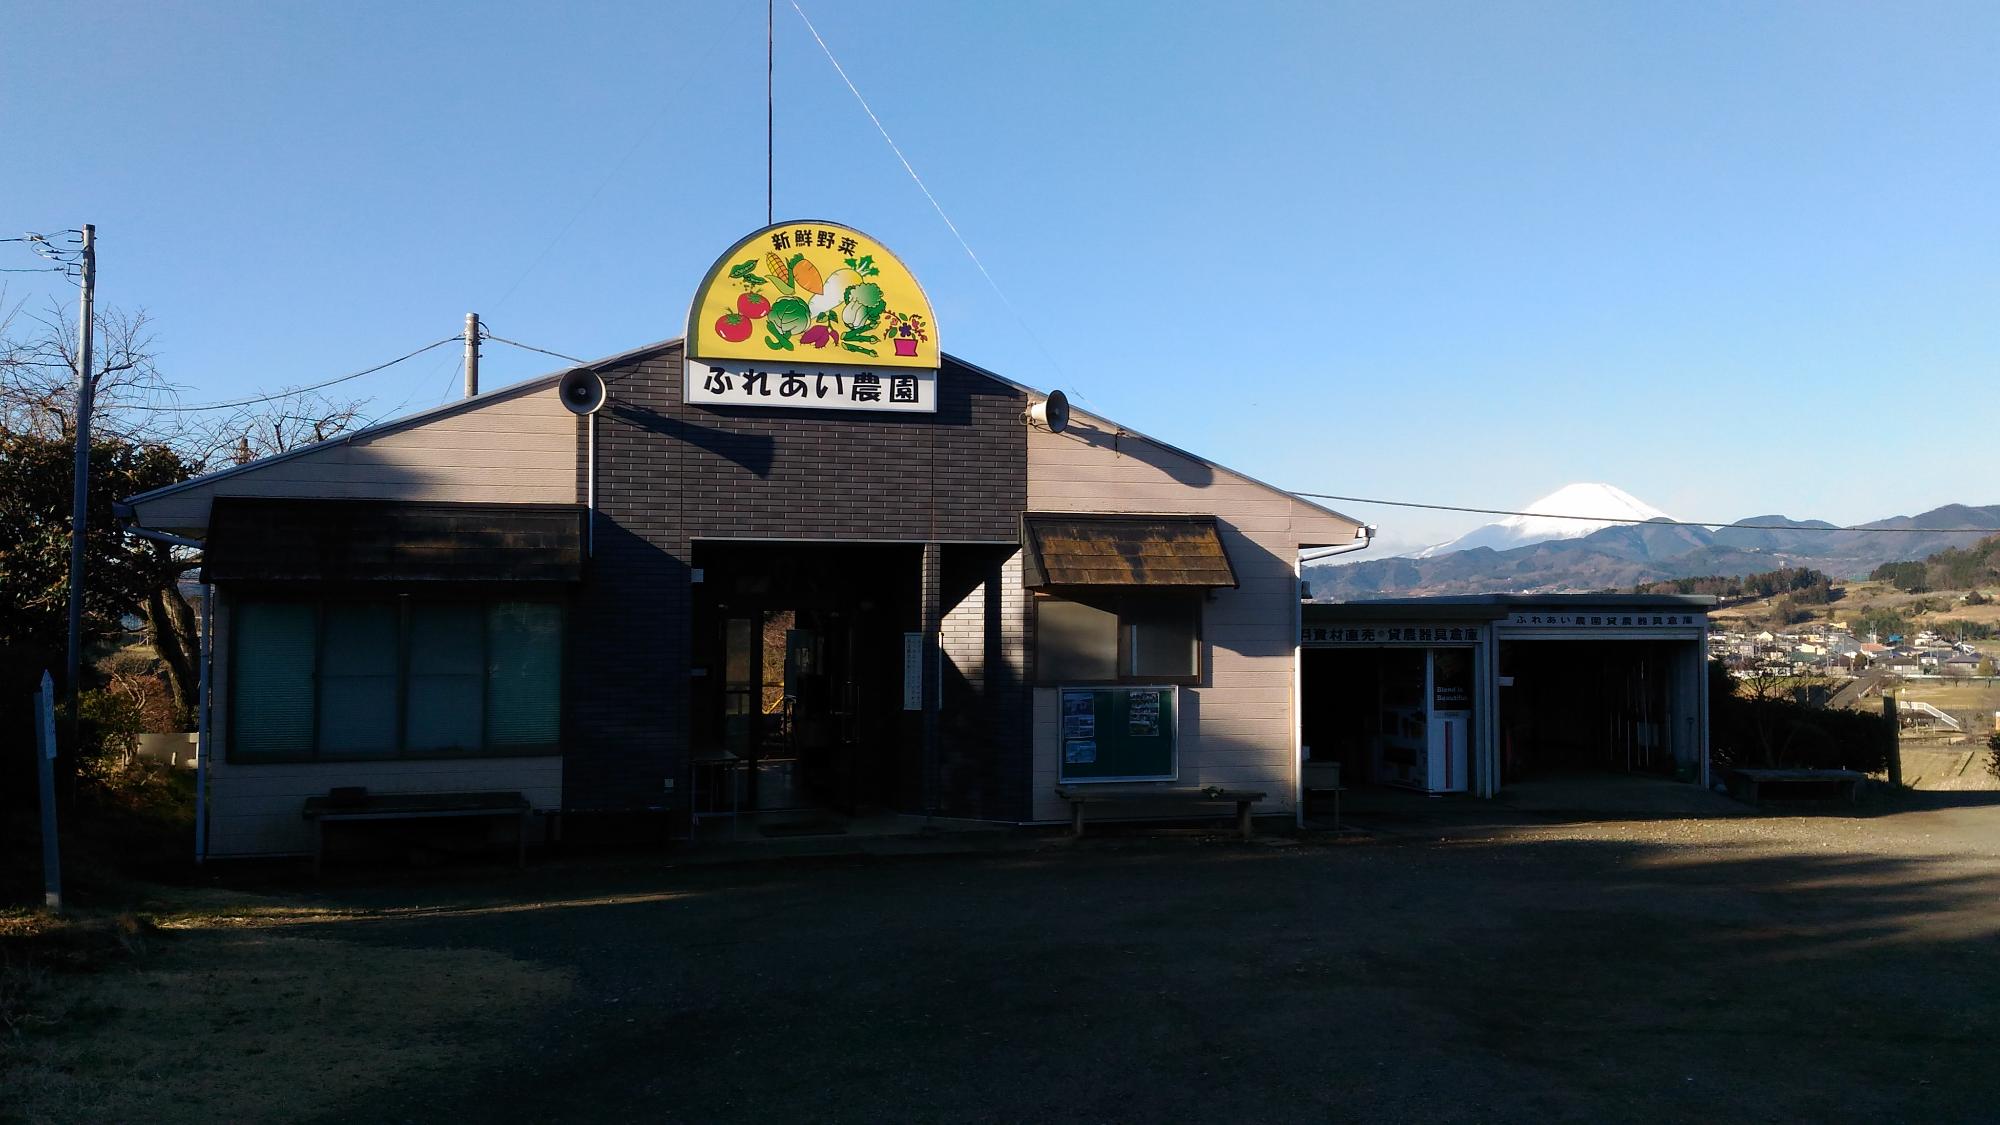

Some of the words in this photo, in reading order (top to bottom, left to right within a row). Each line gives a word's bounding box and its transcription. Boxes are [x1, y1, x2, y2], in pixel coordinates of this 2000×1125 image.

[771, 229, 859, 257] 新鮮野菜
[704, 367, 919, 403] ふれあい農園
